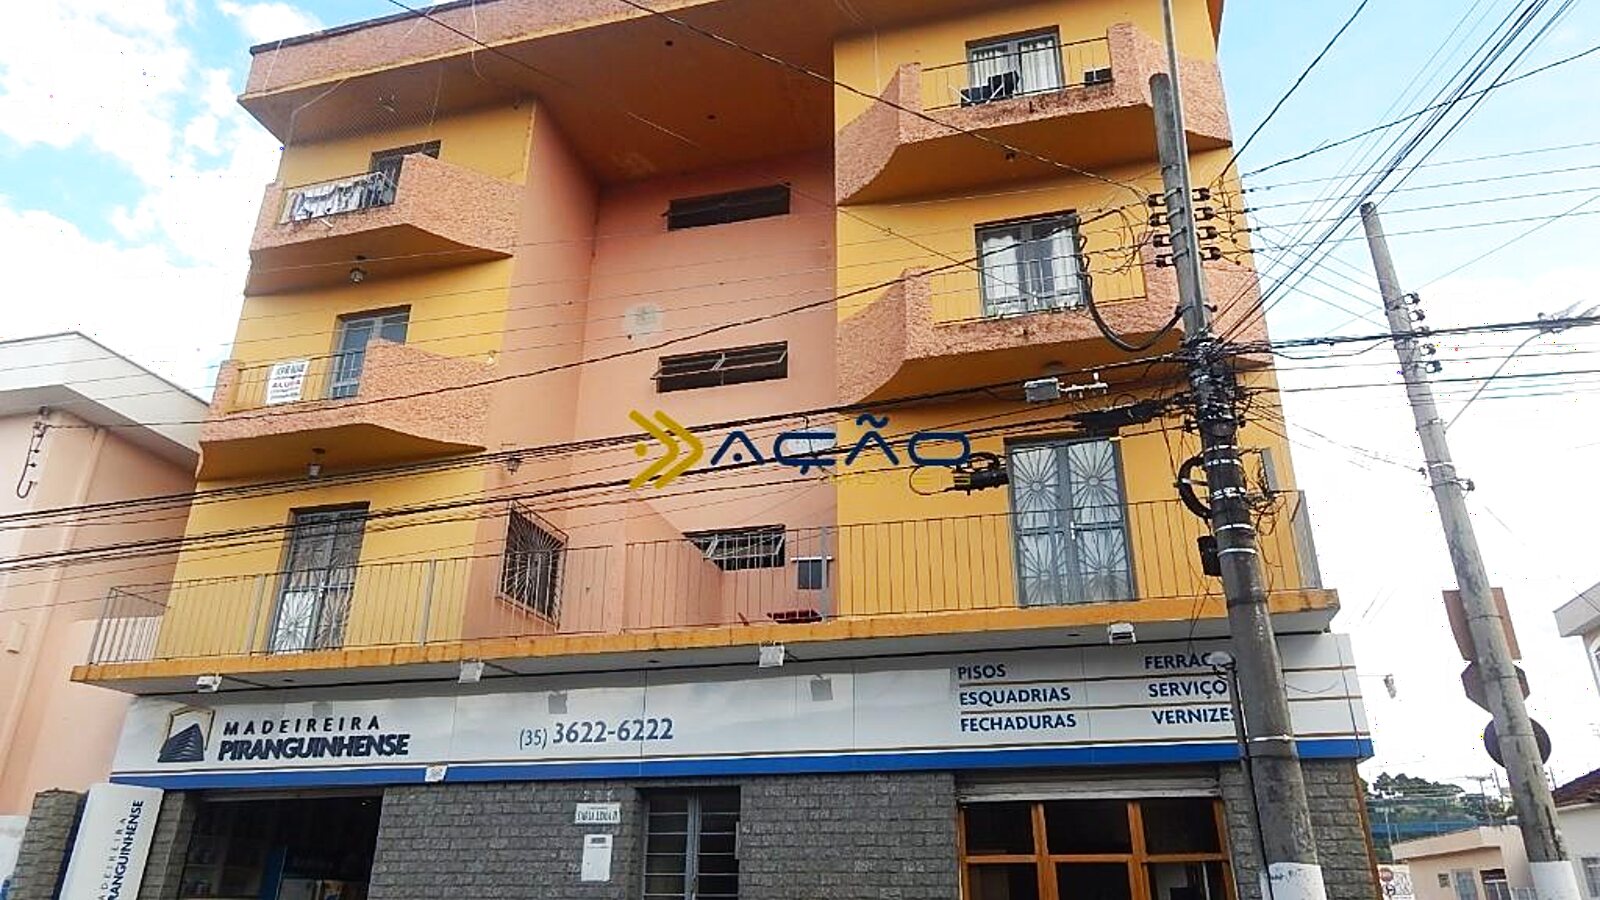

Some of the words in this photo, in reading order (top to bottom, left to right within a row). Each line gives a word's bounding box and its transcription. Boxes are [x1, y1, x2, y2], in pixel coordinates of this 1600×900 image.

[957, 664, 1006, 680] PISOS
[960, 687, 1071, 707] ESQUADRIAS
[1149, 680, 1227, 699] SERVIÇO
[223, 716, 379, 735] MADEIREIRA
[961, 714, 1076, 732] FECHADURAS
[519, 728, 548, 750] (35)
[553, 718, 673, 744] 3622-6222
[217, 734, 410, 761] PIRANGUINHENSE
